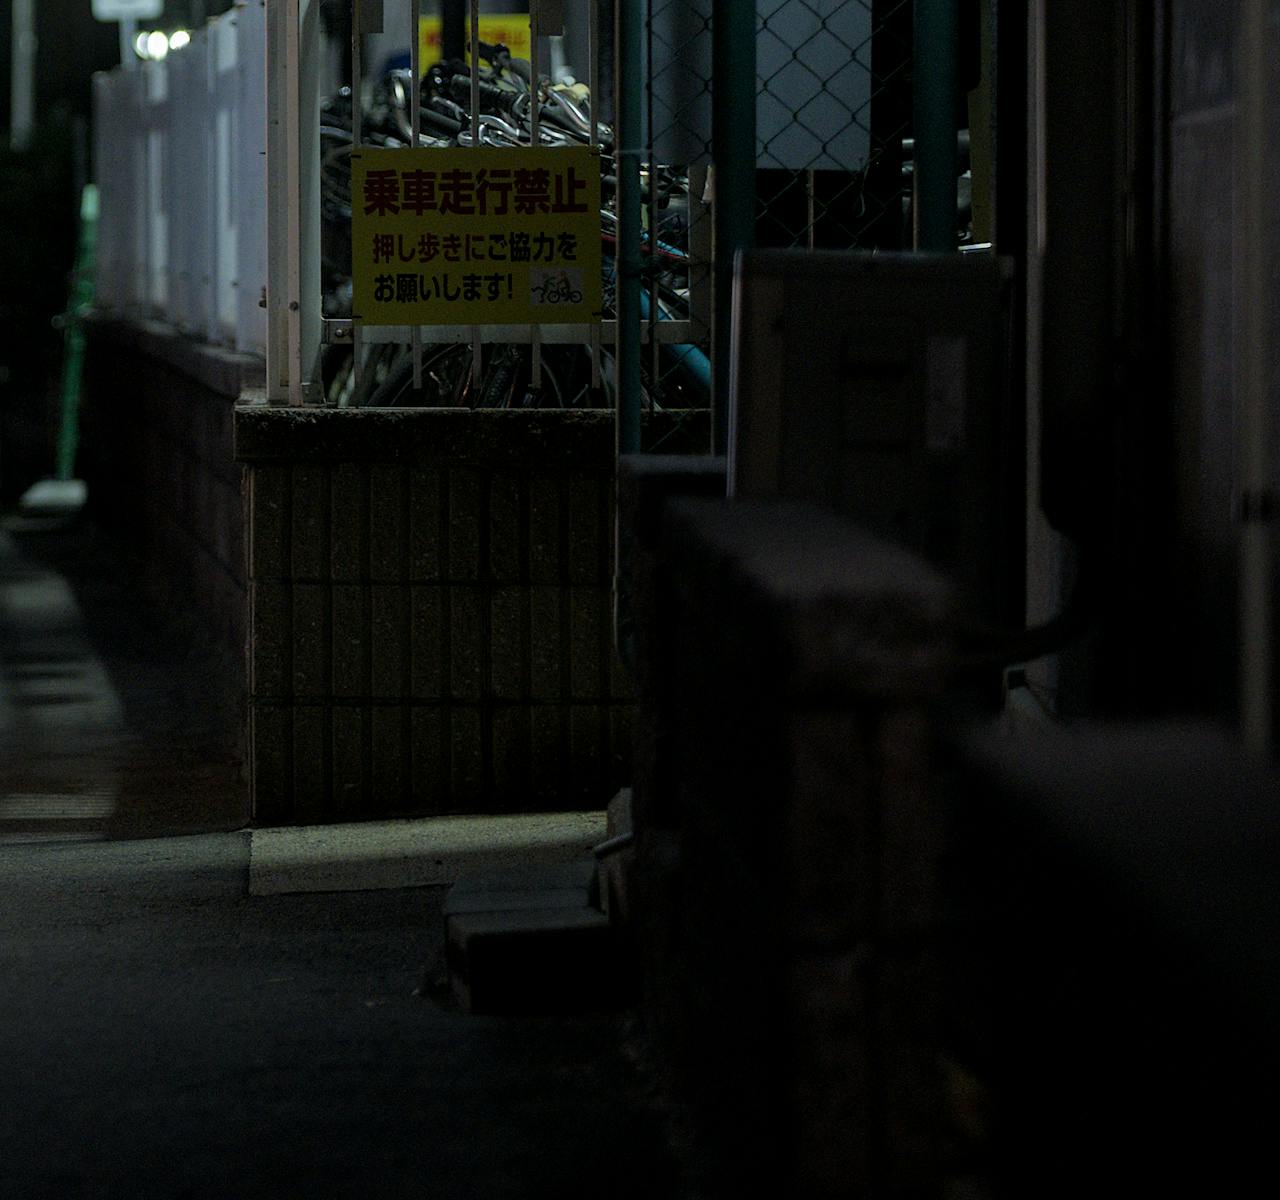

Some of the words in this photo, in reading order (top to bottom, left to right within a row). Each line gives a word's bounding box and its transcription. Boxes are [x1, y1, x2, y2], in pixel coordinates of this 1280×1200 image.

[363, 168, 589, 217] 乗車走行禁止
[372, 232, 578, 264] 押し歩きにご協力を
[373, 273, 514, 303] お願いします!
